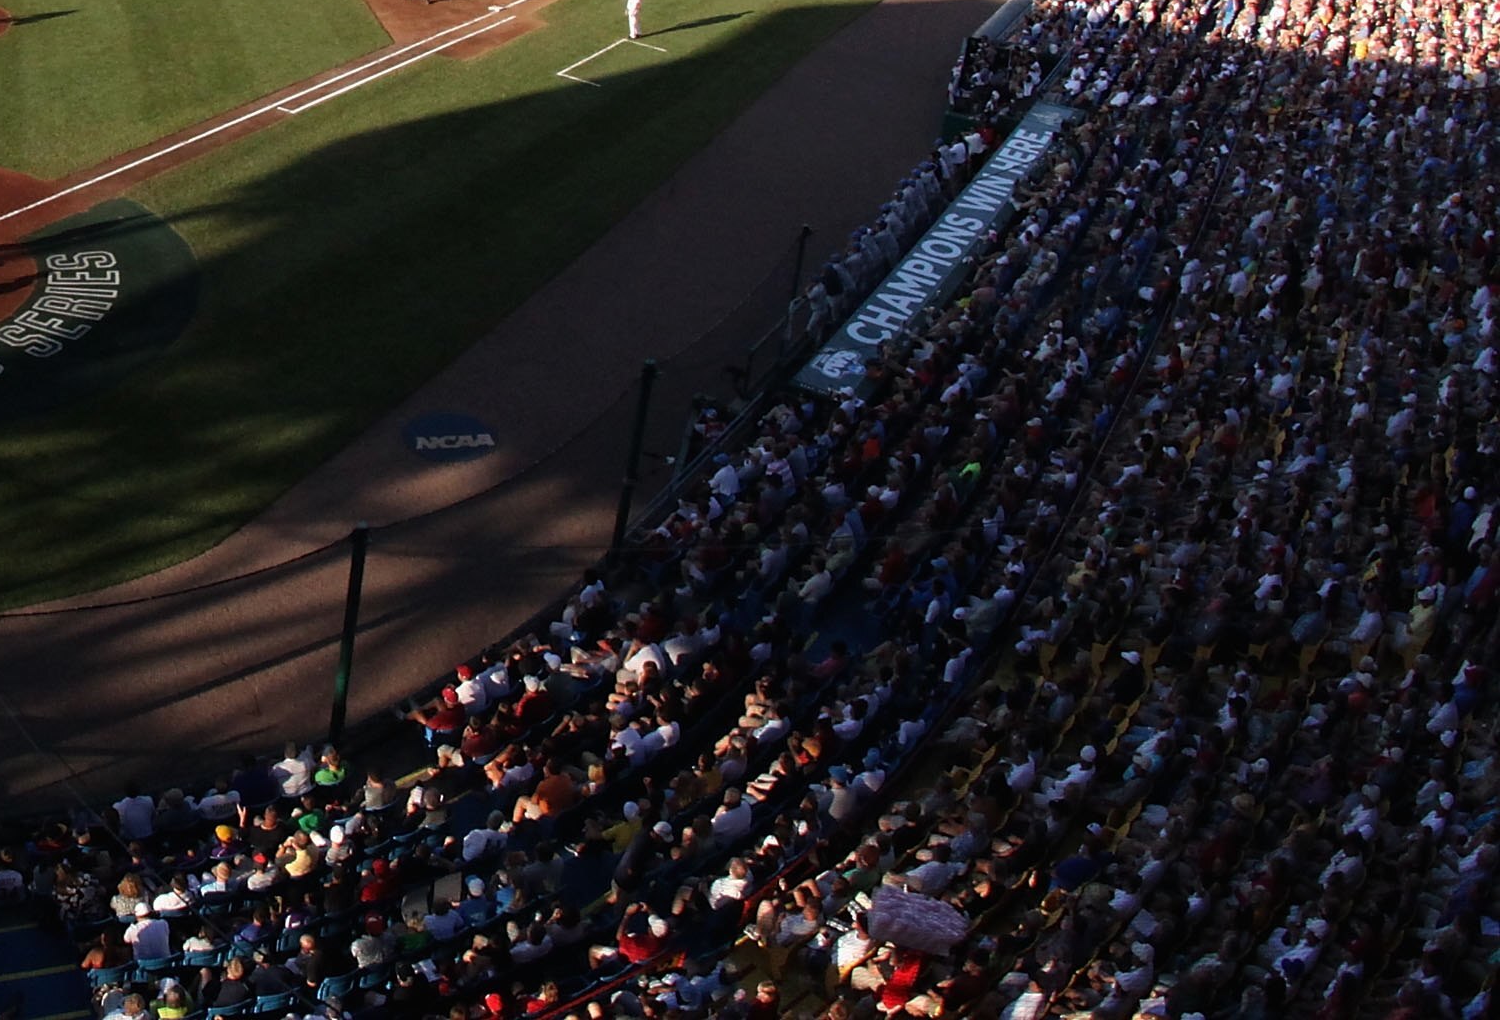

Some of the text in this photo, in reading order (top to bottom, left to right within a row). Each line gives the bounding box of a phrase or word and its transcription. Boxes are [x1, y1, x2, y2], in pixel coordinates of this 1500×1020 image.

[847, 213, 984, 345] CHAMPIONS
[956, 172, 1014, 213] WIN
[415, 433, 496, 451] NCAA
